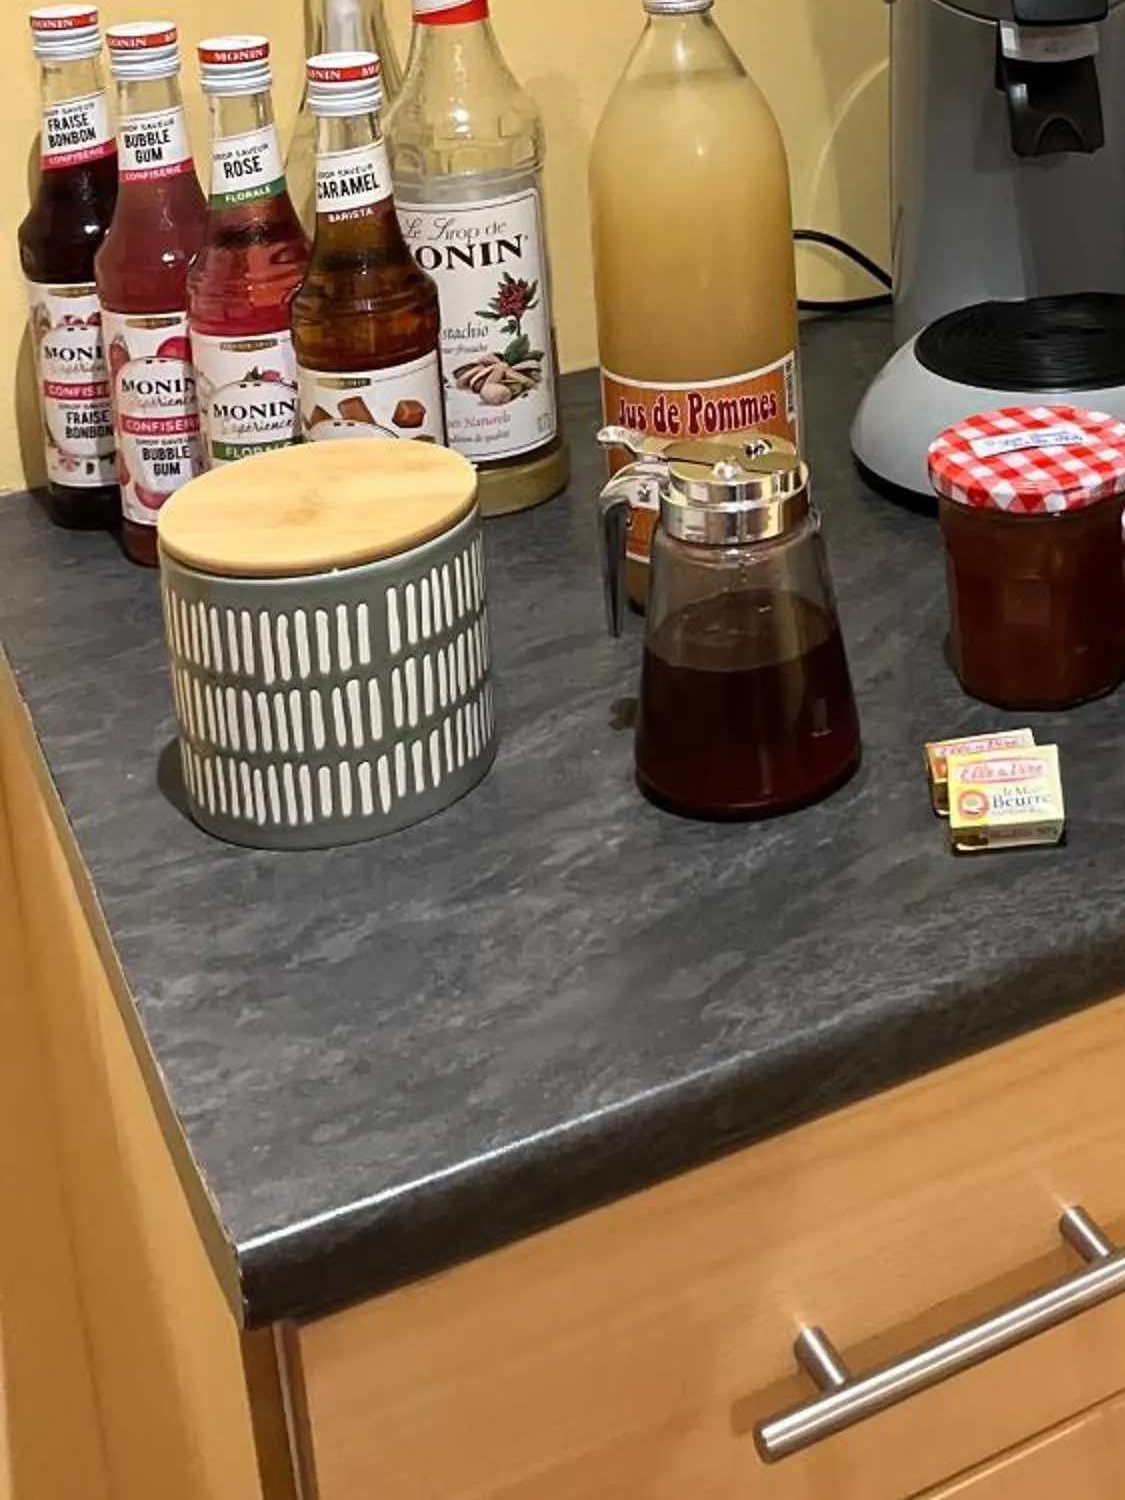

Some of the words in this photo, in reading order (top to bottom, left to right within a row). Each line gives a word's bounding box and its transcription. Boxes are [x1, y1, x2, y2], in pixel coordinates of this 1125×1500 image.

[213, 48, 264, 62] MONIN
[47, 112, 90, 133] FRAISE
[47, 127, 97, 149] BONBON
[123, 129, 171, 149] BUBBLE
[135, 147, 163, 164] GUM
[223, 155, 263, 179] ROSE
[225, 184, 271, 203] FLORALE
[327, 208, 375, 222] BARISTA
[427, 216, 480, 244] Sirop
[485, 218, 507, 237] de
[415, 233, 525, 271] ONIN
[44, 346, 103, 362] MONI
[65, 410, 110, 424] FRAISE
[213, 398, 297, 420] MONIN
[619, 398, 648, 431] Jus
[653, 394, 680, 434] de
[687, 389, 778, 435] Pommes
[141, 446, 191, 461] BUBBLE
[152, 461, 181, 476] GUM
[992, 793, 1049, 809] Beurre
